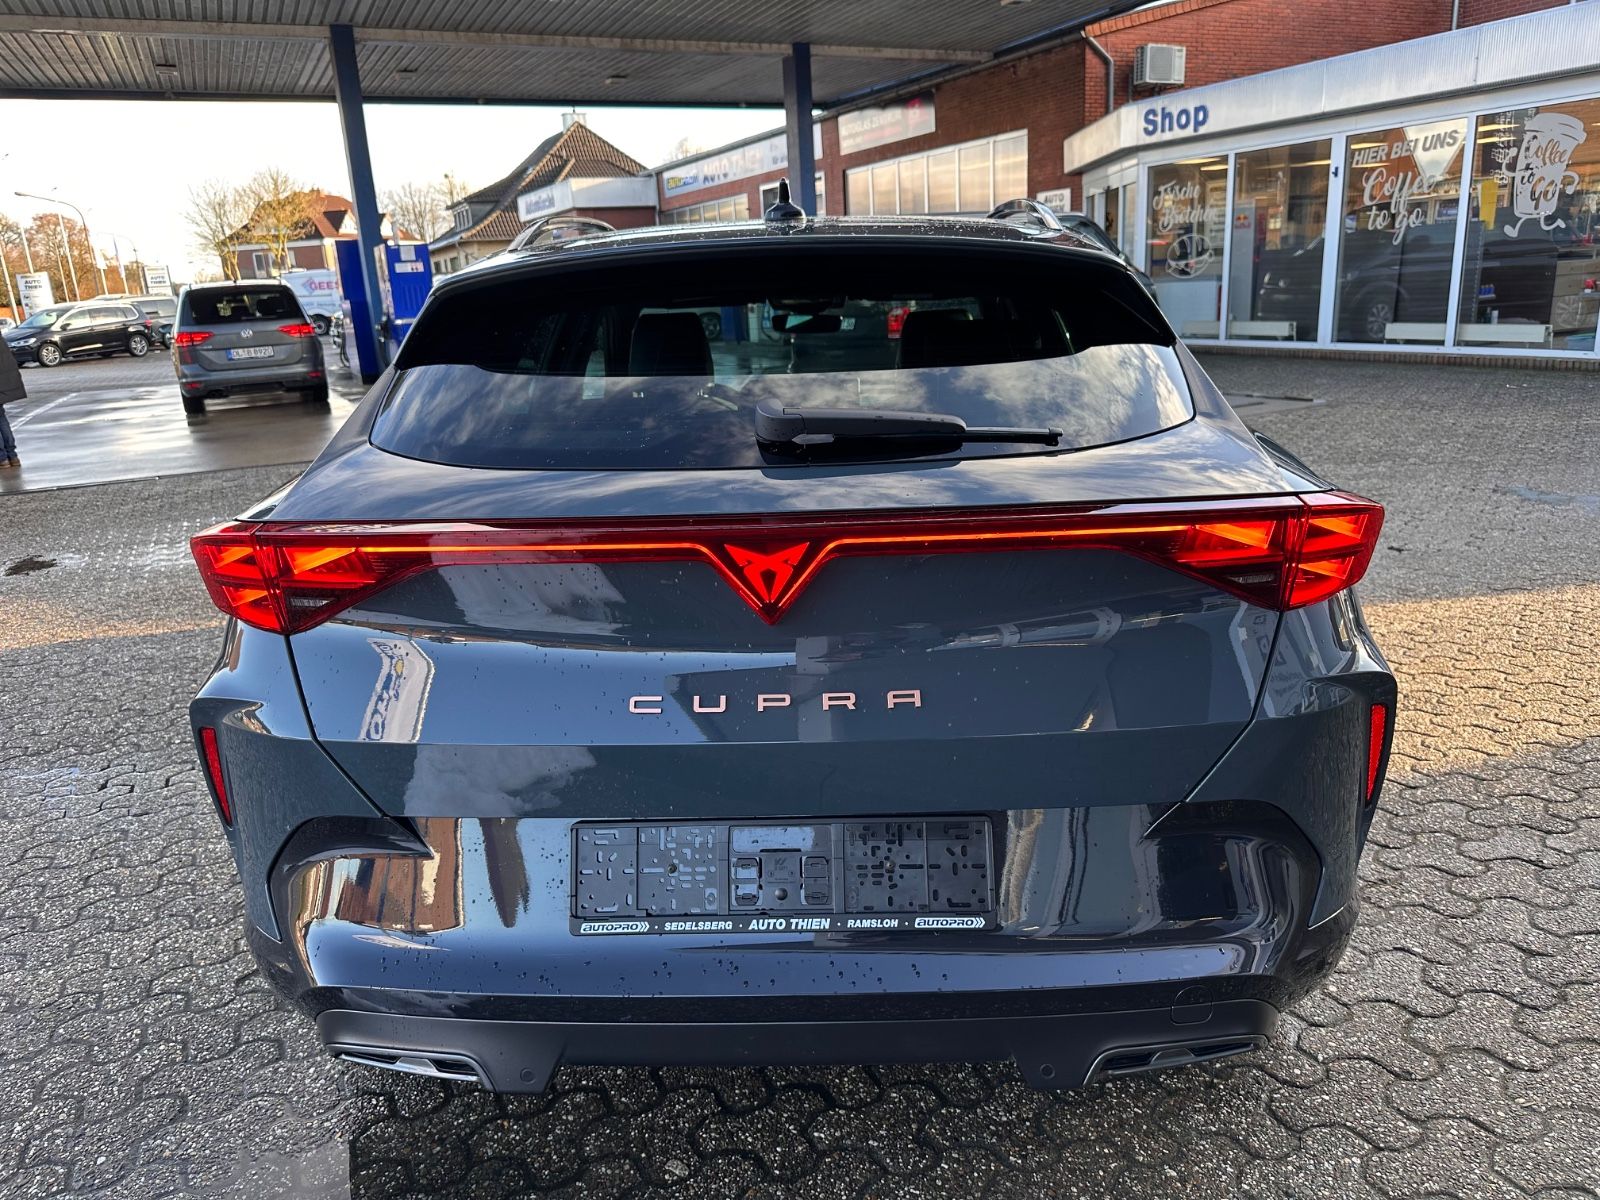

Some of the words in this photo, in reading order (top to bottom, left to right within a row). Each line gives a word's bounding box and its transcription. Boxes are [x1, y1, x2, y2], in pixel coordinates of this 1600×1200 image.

[1143, 104, 1209, 137] Shop
[1352, 145, 1389, 168] HIER
[1390, 138, 1419, 160] BEI
[1422, 130, 1459, 152] UNS
[1044, 192, 1065, 204] AUTO
[1362, 168, 1437, 213] Coffee
[1366, 206, 1391, 230] to
[1393, 208, 1424, 245] go
[629, 690, 922, 714] CUPRA
[664, 921, 733, 931] SEDELSBERG
[749, 919, 786, 931] AUTO
[789, 918, 830, 930] THIEN
[847, 918, 899, 928] RAMSLOH
